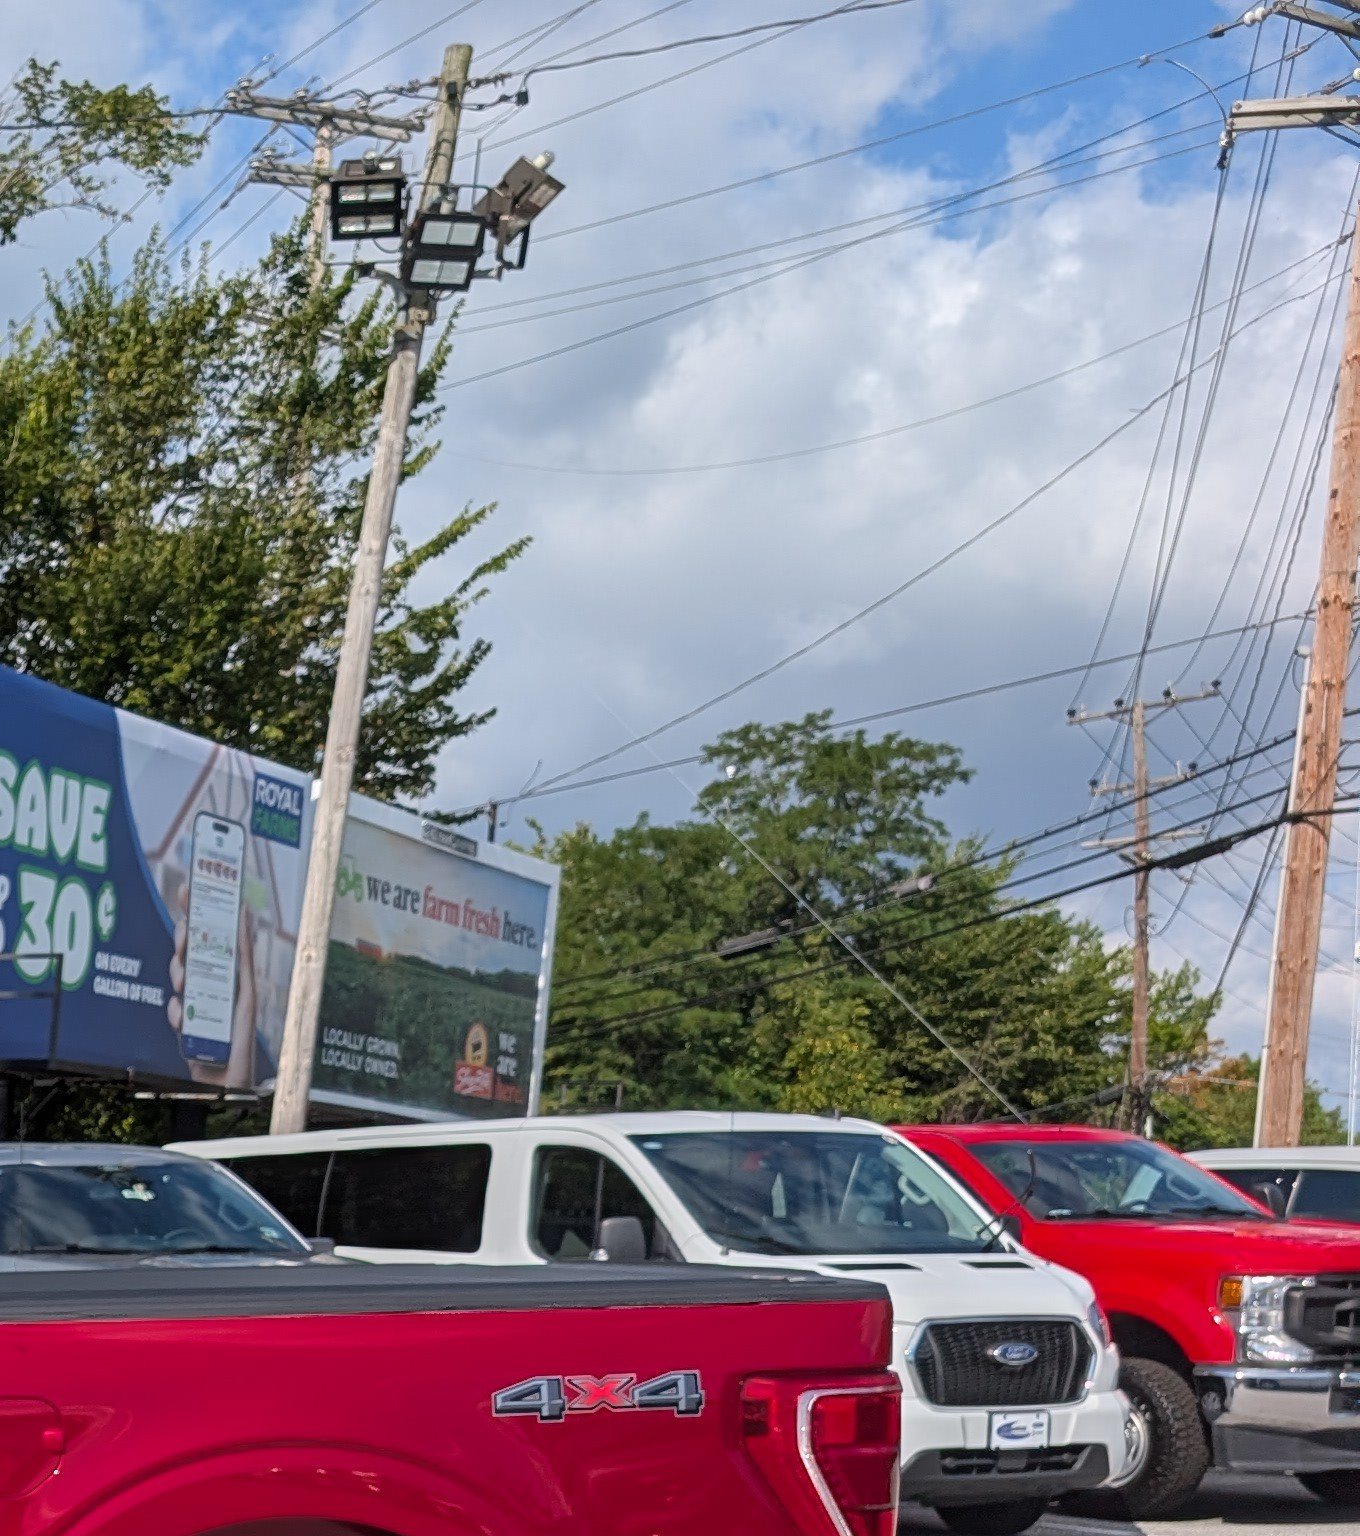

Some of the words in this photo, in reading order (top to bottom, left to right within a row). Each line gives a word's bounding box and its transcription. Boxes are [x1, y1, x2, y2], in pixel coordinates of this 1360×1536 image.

[255, 778, 300, 816] ROYAL
[366, 875, 392, 906] we
[393, 884, 420, 915] are
[422, 884, 460, 927] farm
[463, 898, 501, 940] fresh
[94, 950, 110, 971] ON
[323, 1026, 366, 1051] LOCALLY
[321, 1047, 364, 1072] LOCALLY
